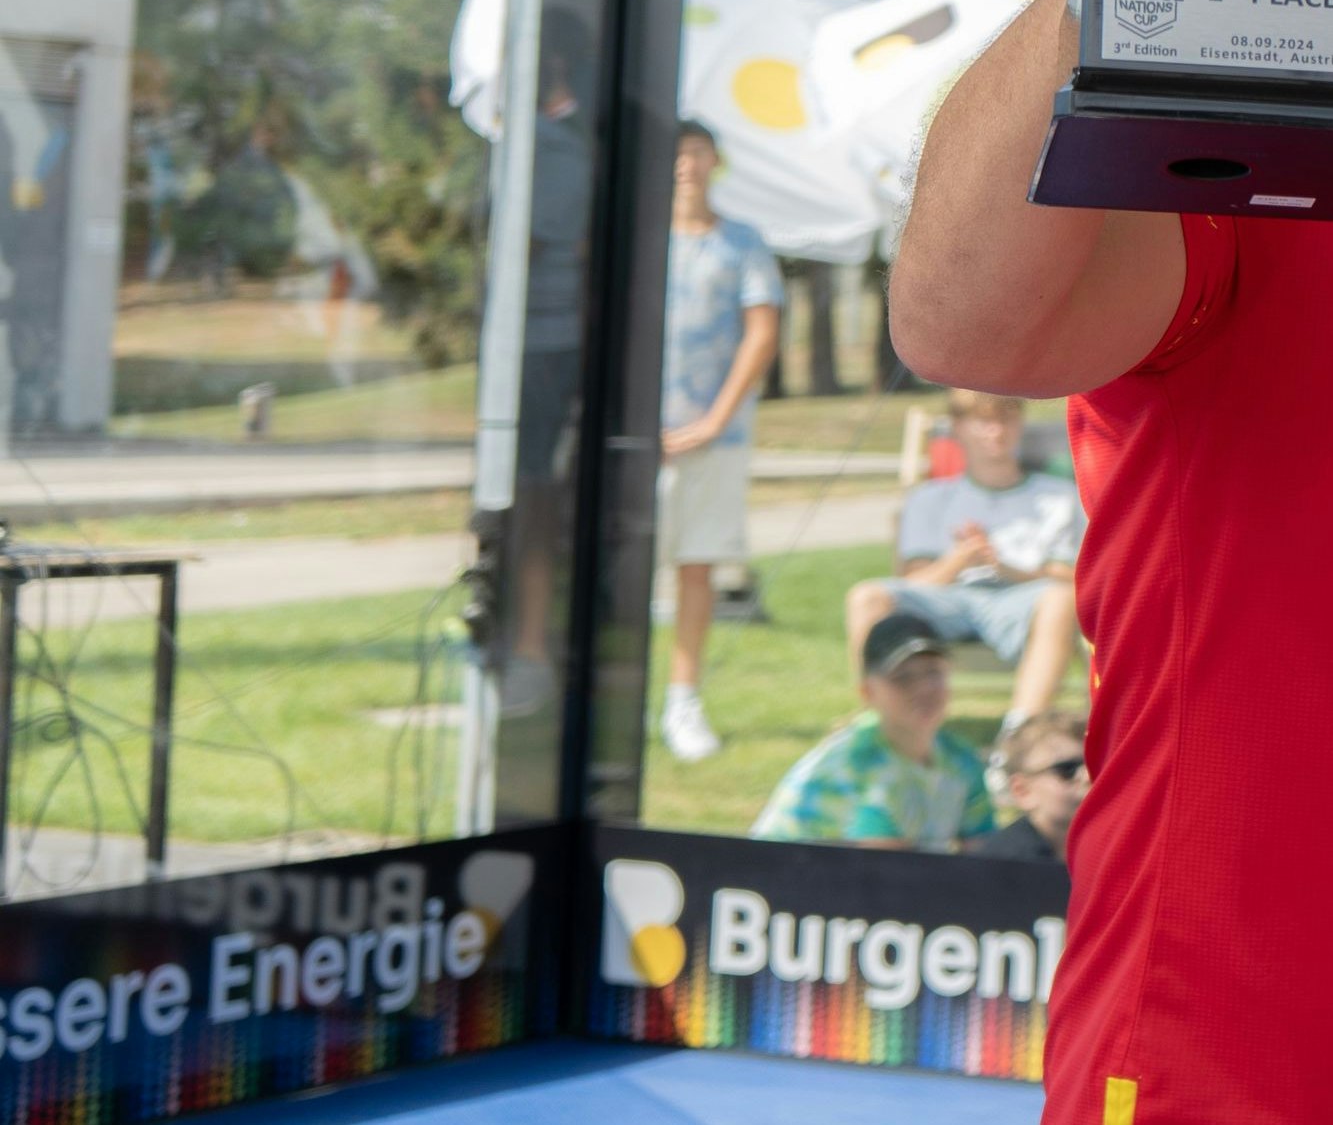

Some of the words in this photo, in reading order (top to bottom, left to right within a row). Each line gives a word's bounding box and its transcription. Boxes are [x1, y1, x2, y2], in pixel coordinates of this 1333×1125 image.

[1119, 0, 1173, 14] NATIONS
[1134, 13, 1158, 26] CUP
[1113, 41, 1131, 55] 3rd
[1134, 43, 1178, 57] Edition
[1230, 35, 1315, 51] 08.09.2024
[1199, 46, 1284, 64] Eisenstadt,
[0, 962, 193, 1063] sere
[208, 897, 488, 1014] Energie
